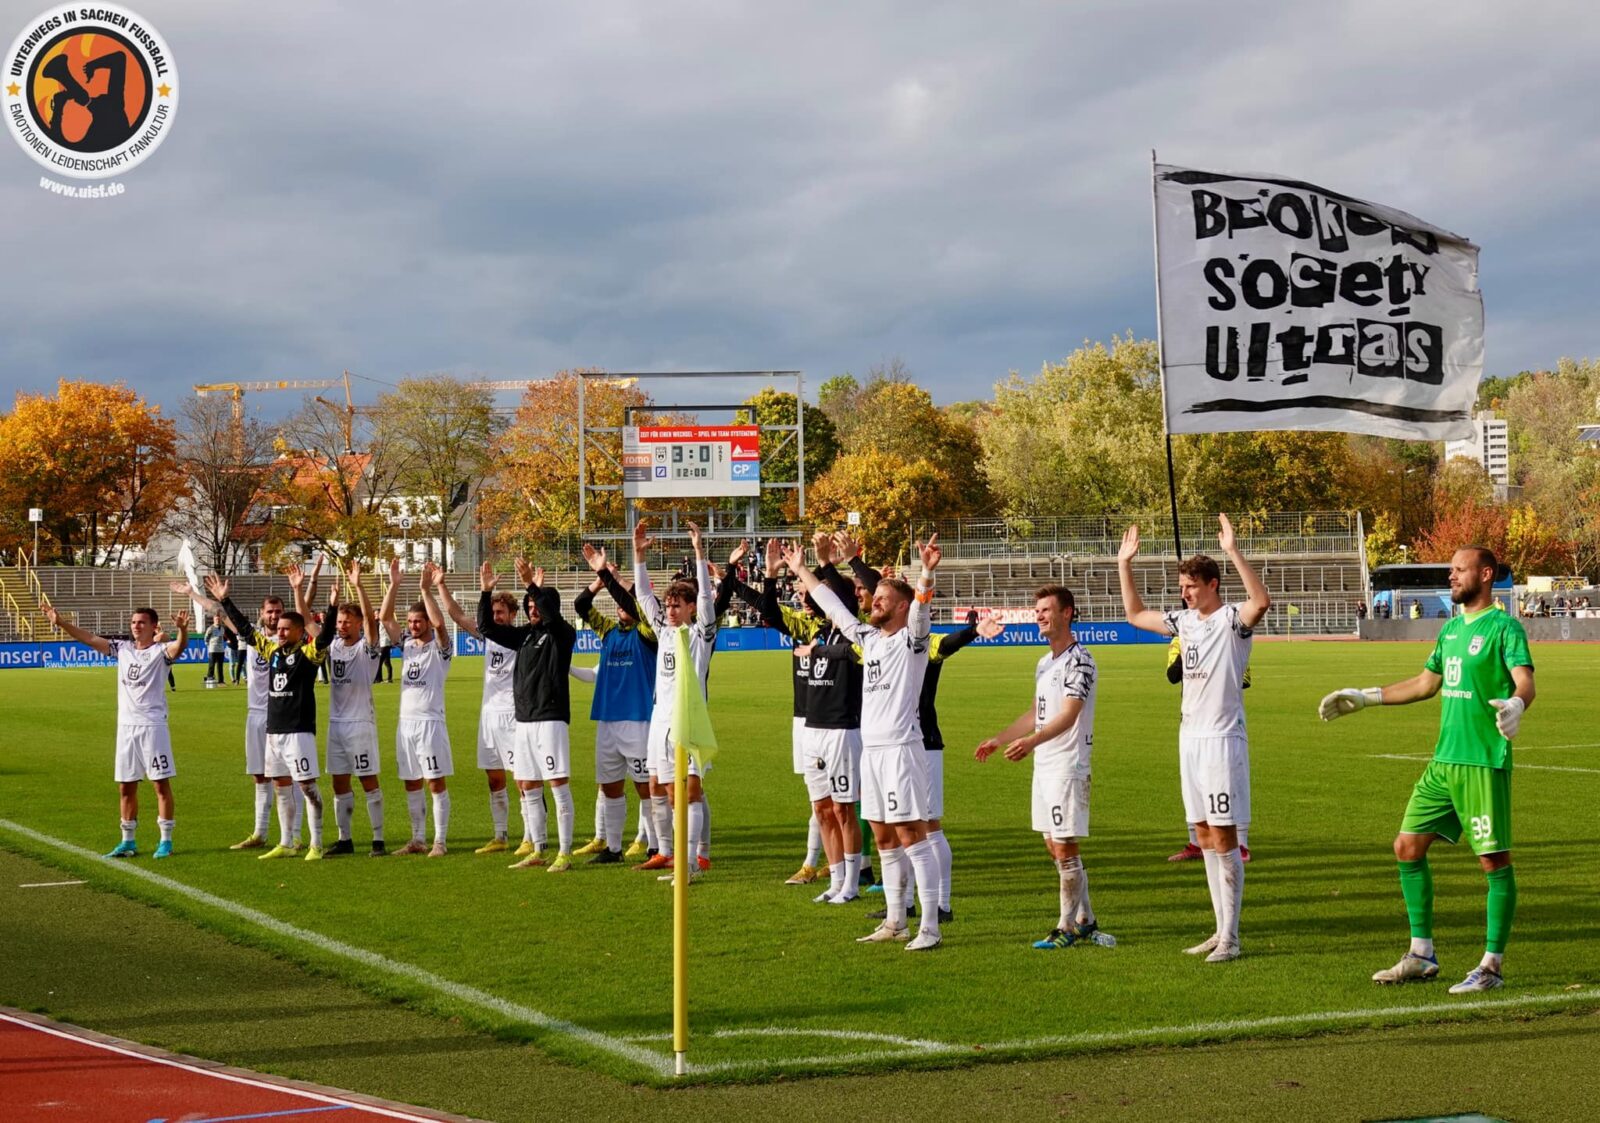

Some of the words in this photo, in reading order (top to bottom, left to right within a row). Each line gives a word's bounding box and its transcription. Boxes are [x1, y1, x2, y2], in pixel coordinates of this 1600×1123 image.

[733, 464, 750, 474] CP
[401, 518, 410, 528] G
[151, 754, 169, 771] 43
[294, 757, 310, 774] 10
[354, 754, 370, 770] 15
[426, 755, 439, 771] 11
[545, 755, 555, 771] 9
[830, 775, 850, 794] 19
[888, 791, 898, 812] 5
[1208, 792, 1230, 815] 18
[1051, 805, 1063, 827] 6
[1471, 815, 1492, 840] 39
